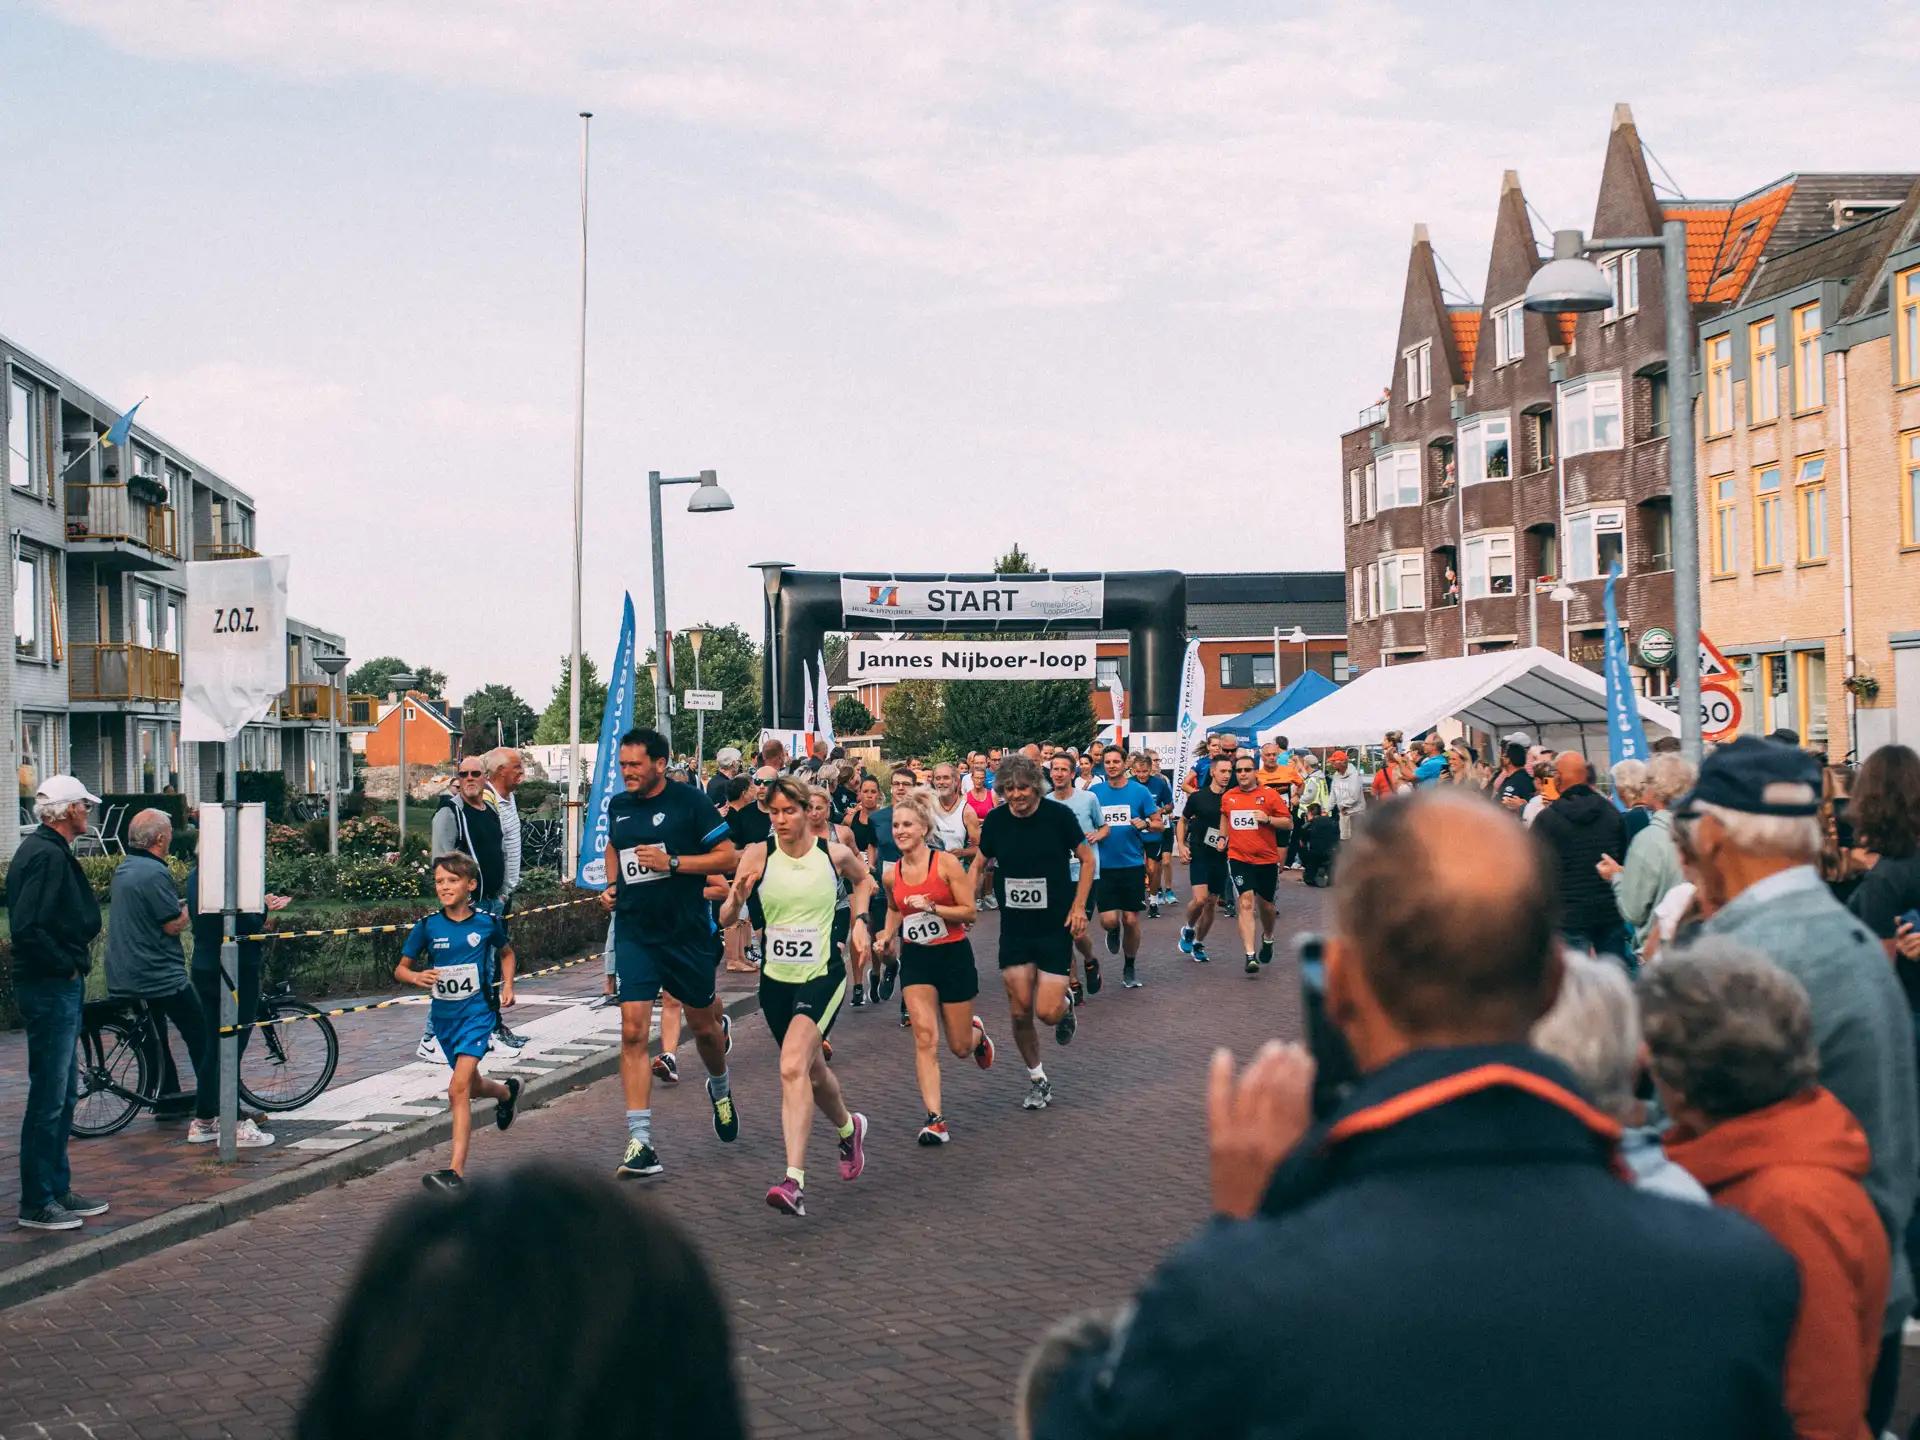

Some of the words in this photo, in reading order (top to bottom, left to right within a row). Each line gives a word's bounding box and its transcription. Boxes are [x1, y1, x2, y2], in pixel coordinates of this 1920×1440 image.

[927, 589, 1019, 612] START
[213, 607, 259, 633] Z.O.Z.
[858, 651, 933, 671] Jannes
[941, 651, 1087, 673] Nijboer-loop
[1104, 812, 1127, 823] 655
[1233, 817, 1255, 827] 654
[1010, 889, 1042, 903] 620
[907, 921, 940, 940] 619
[773, 939, 813, 957] 652
[436, 977, 474, 993] 604
